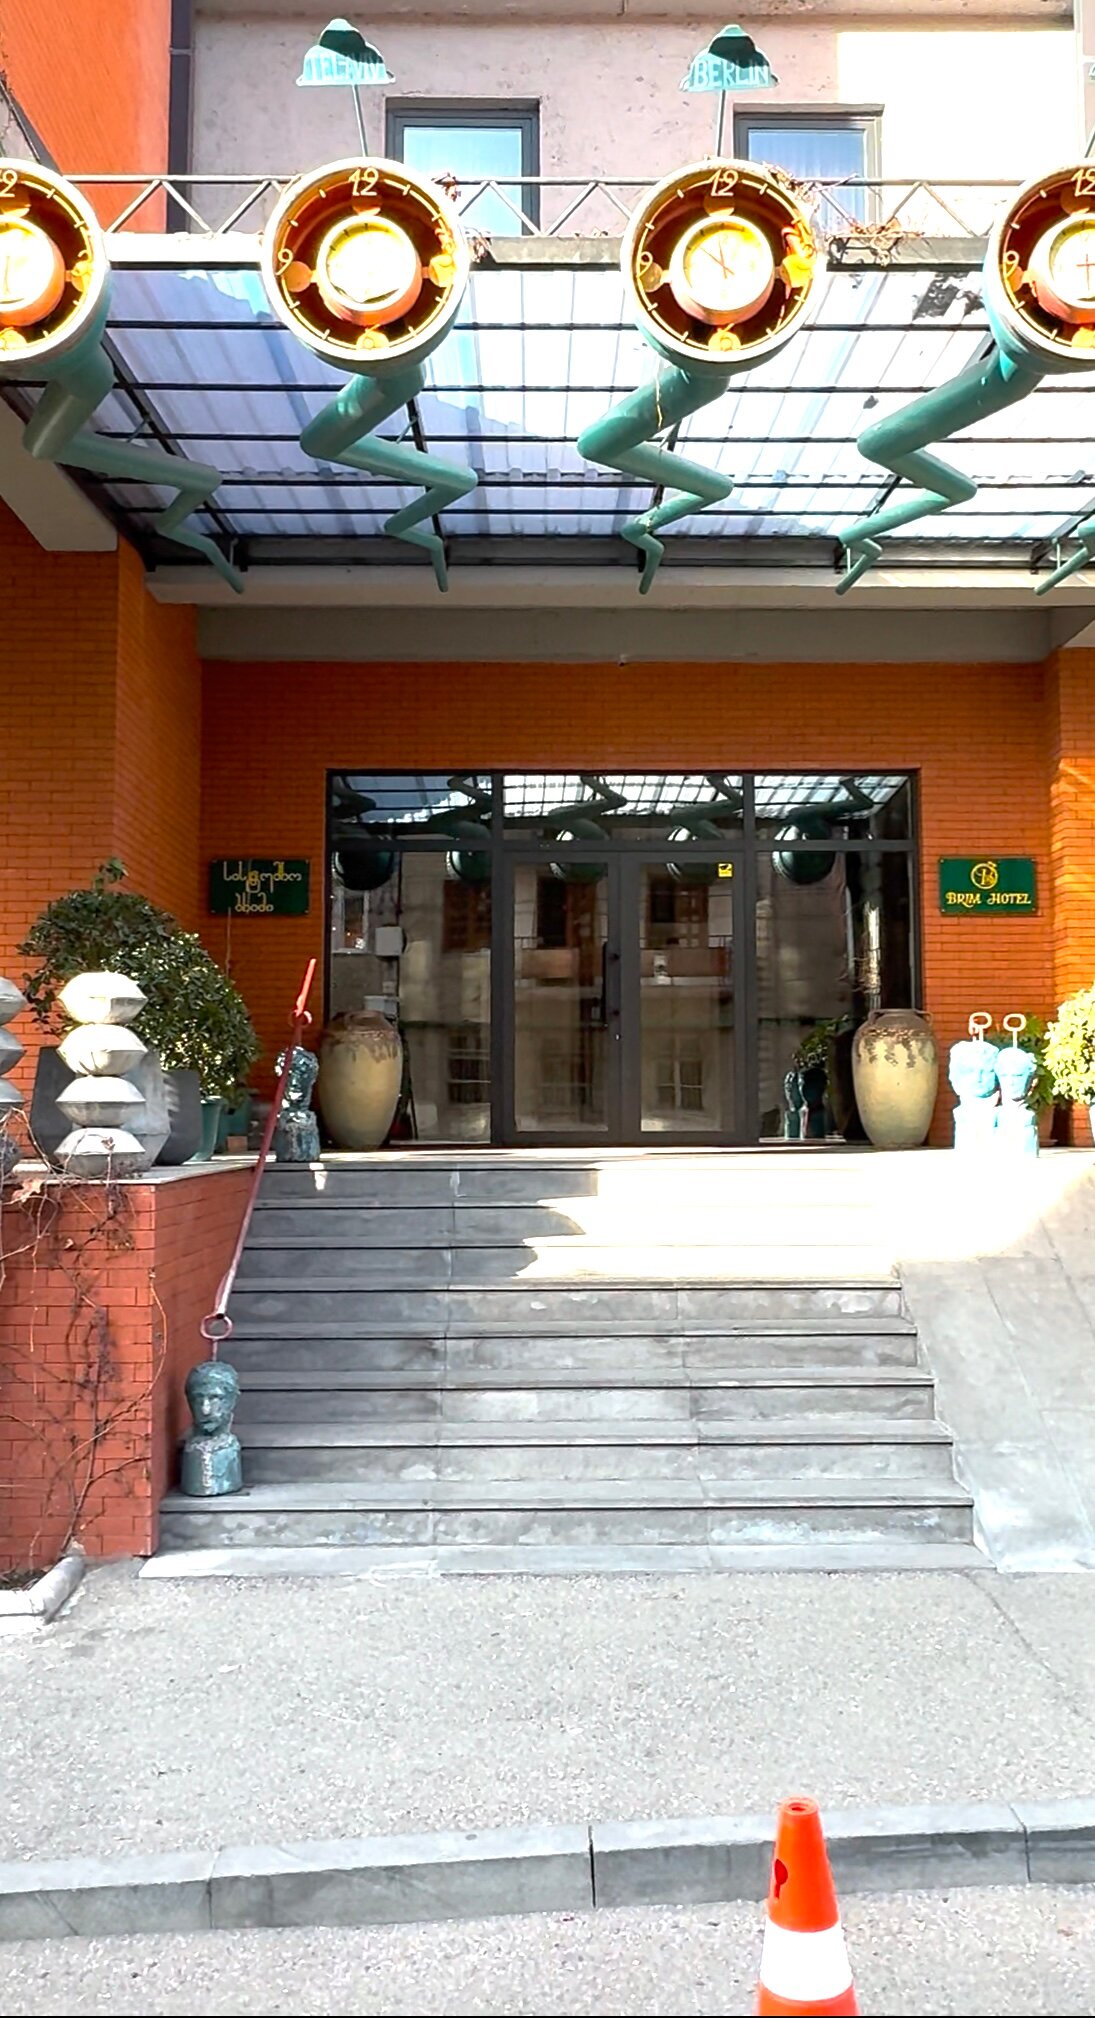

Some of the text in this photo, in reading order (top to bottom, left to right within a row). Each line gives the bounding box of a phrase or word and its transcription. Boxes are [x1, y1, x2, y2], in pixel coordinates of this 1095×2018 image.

[693, 59, 769, 88] BERLIN
[0, 169, 18, 197] 2
[348, 167, 379, 196] 12
[707, 169, 739, 197] 12
[275, 248, 293, 276] 9
[636, 251, 653, 277] 9
[1004, 251, 1019, 278] 9
[986, 892, 1032, 905] HOTEL
